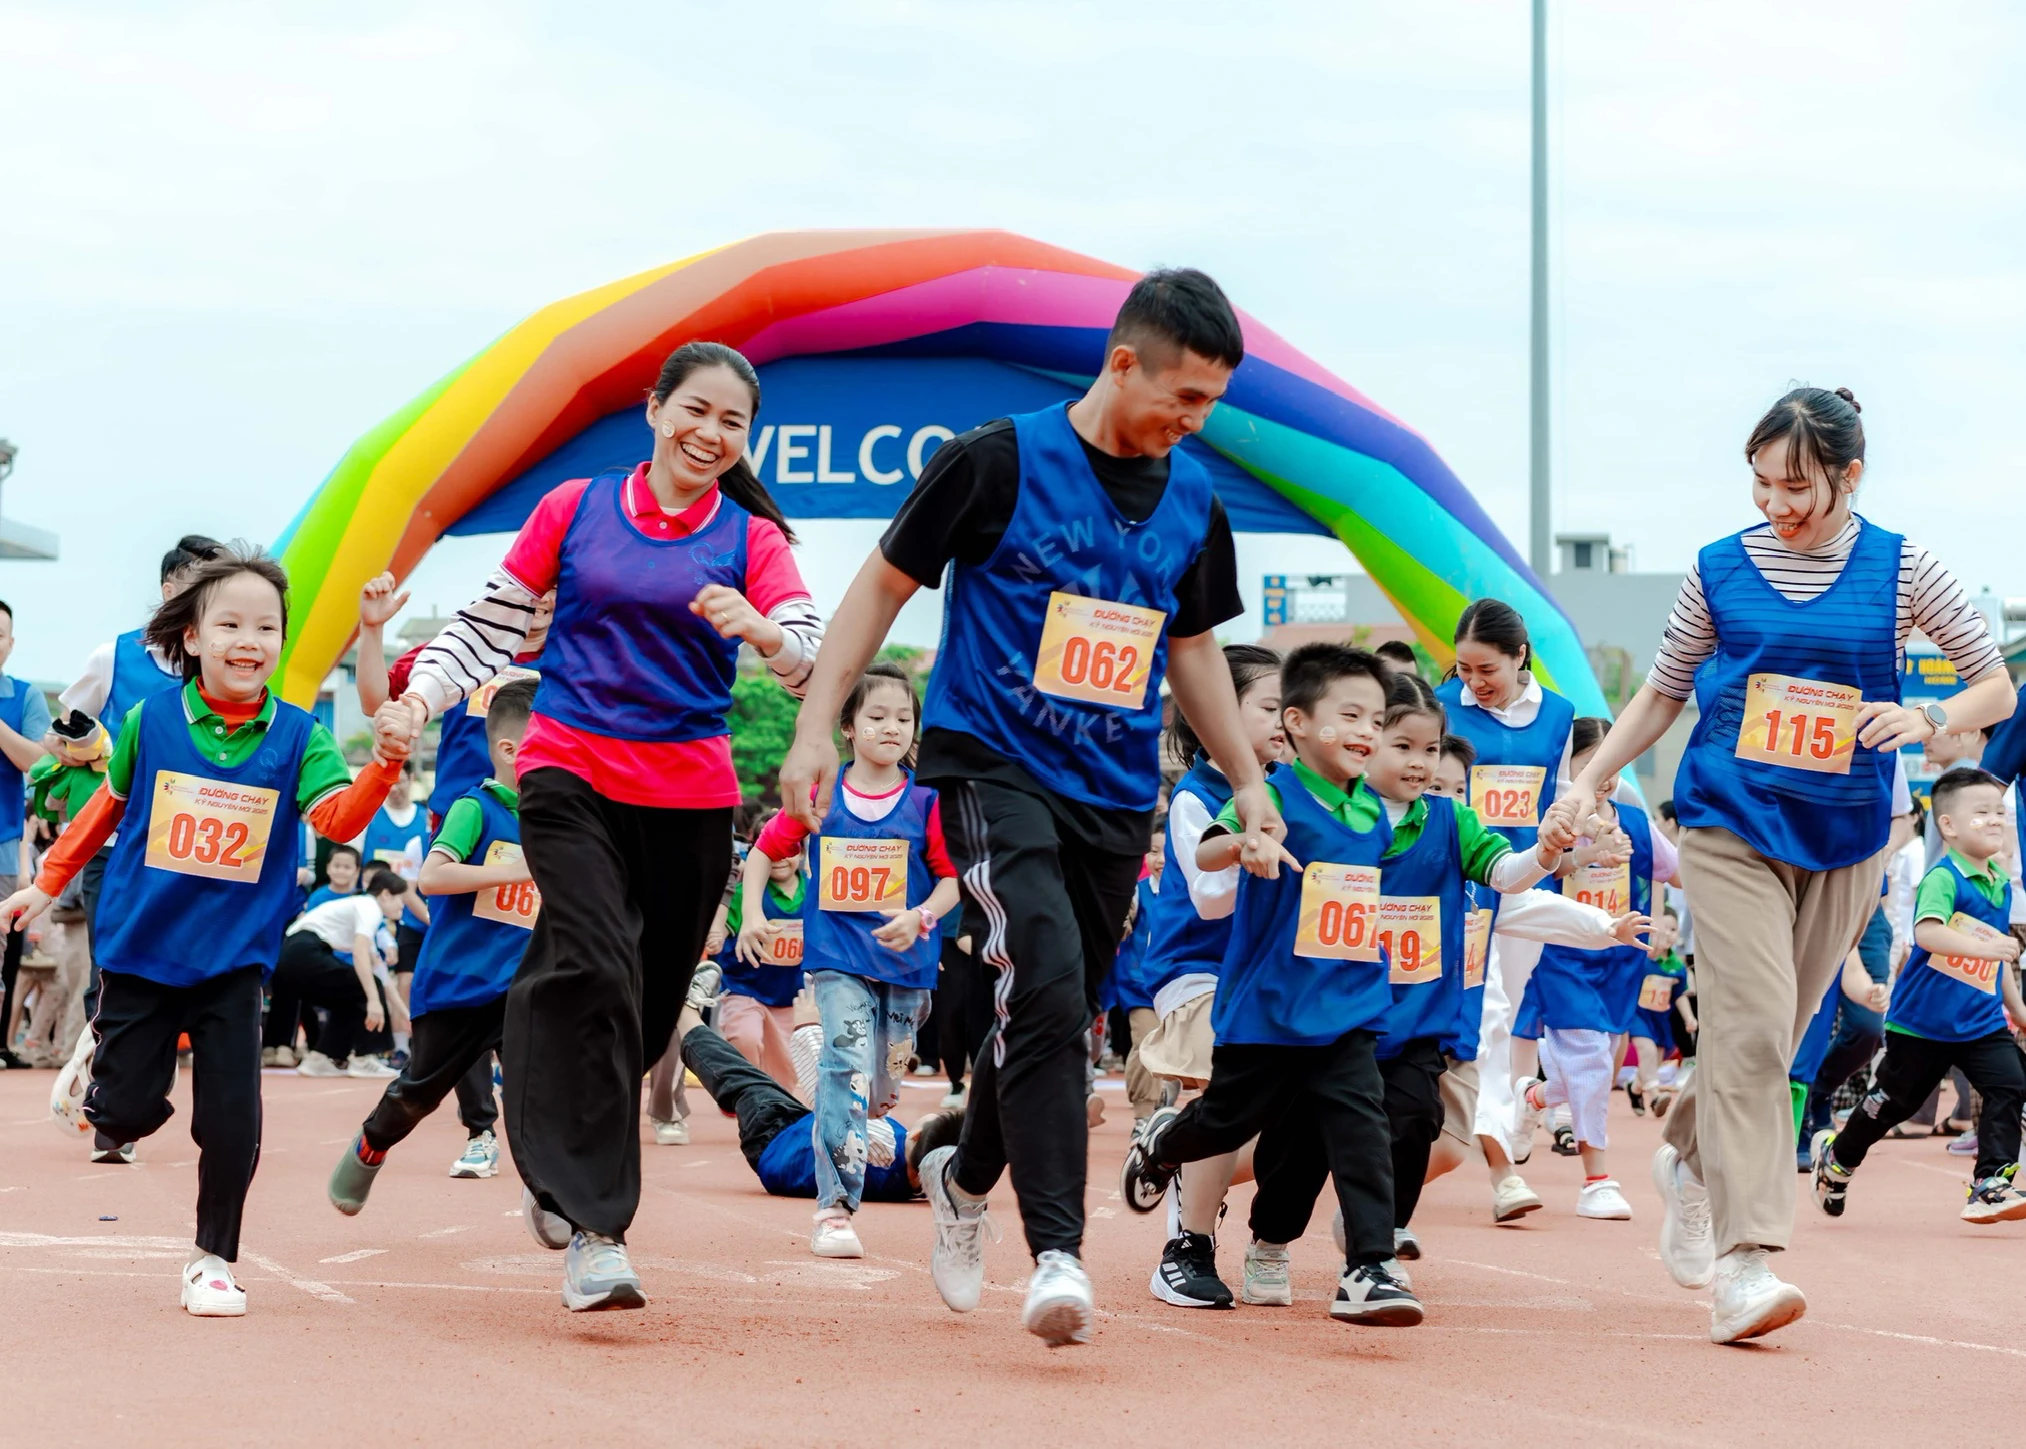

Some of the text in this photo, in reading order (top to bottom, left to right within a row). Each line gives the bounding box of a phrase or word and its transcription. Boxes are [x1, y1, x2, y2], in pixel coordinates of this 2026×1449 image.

[746, 425, 957, 485] ELCO
[1012, 516, 1094, 585] NEW
[1062, 636, 1138, 693] 062
[1766, 710, 1835, 759] 115
[1485, 789, 1530, 818] 023
[168, 812, 249, 868] 032
[496, 880, 534, 916] 06
[832, 866, 891, 901] 097
[1380, 902, 1407, 912] ƯỜNG
[1379, 930, 1420, 972] 19
